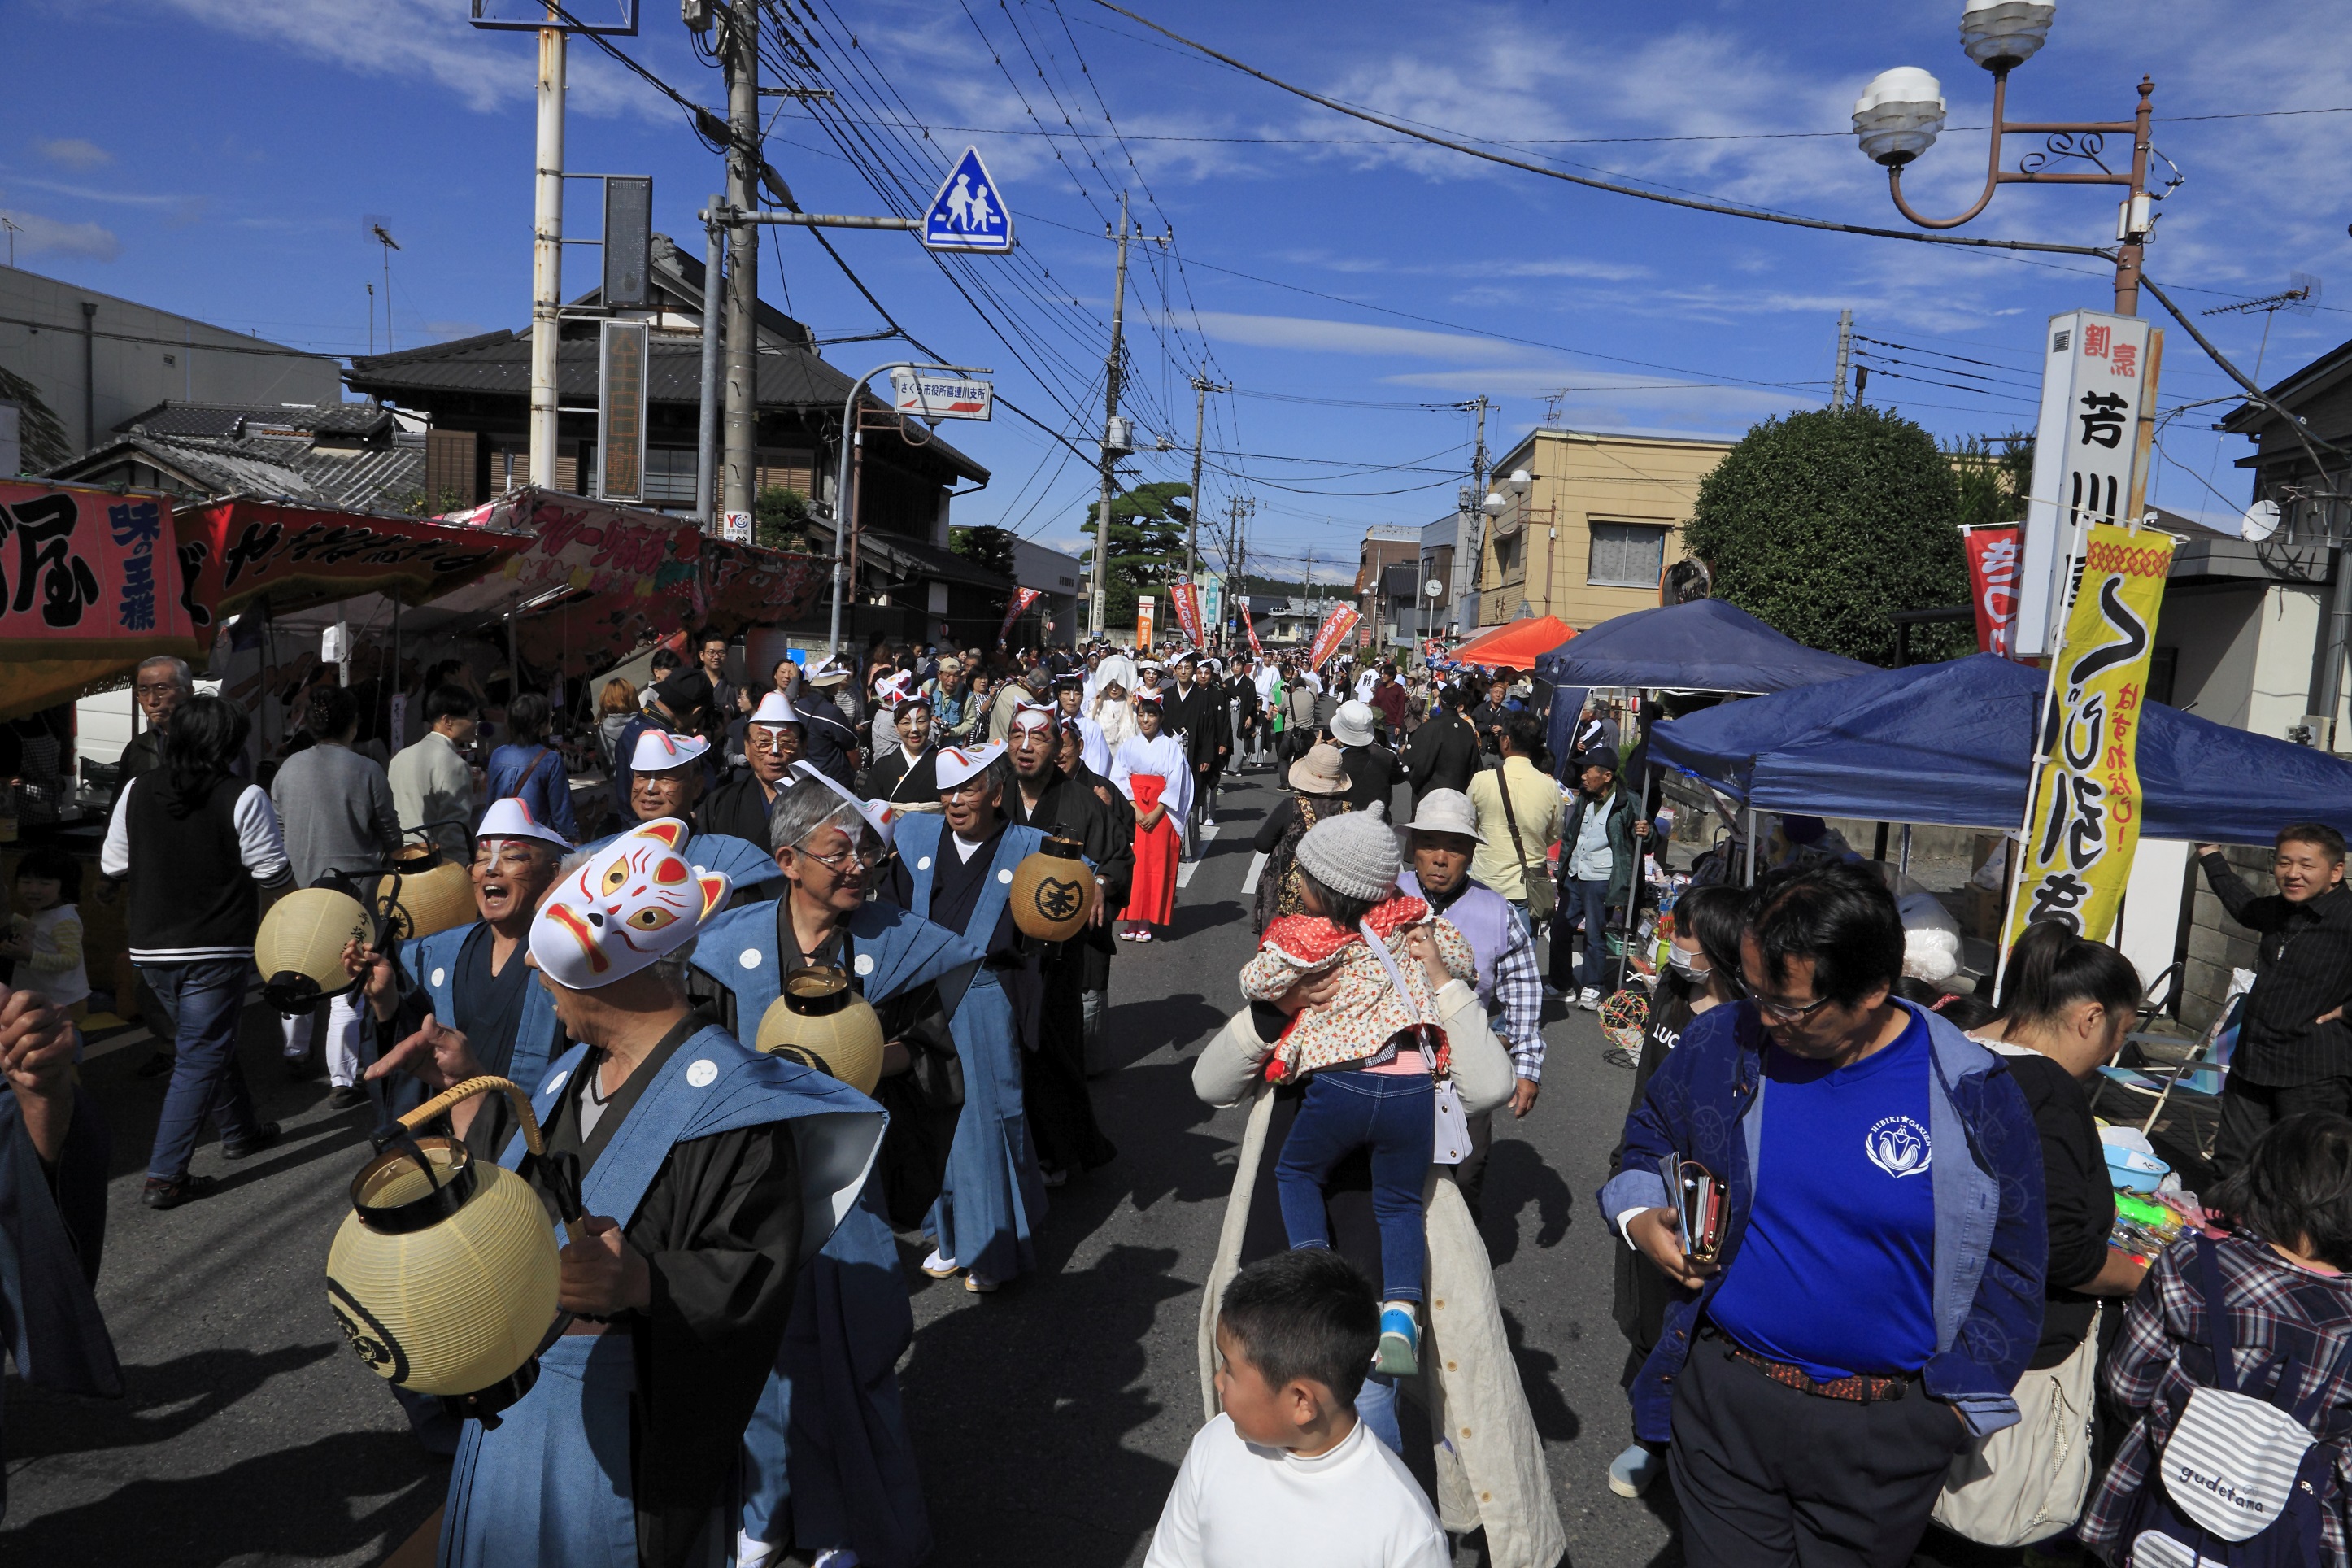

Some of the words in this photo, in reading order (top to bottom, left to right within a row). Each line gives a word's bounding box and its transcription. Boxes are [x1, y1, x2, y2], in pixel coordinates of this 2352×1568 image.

[2084, 323, 2137, 379] 割烹
[607, 330, 640, 493] 全自動
[900, 381, 986, 400] さくら市役所喜連川支所
[2059, 390, 2128, 608] 芳川
[107, 501, 161, 631] 味の王様
[340, 911, 370, 957] 手塚
[1871, 1116, 1900, 1134] HIBIKI
[1908, 1119, 1932, 1147] GAKUEN
[2178, 1465, 2264, 1514] gudetama
